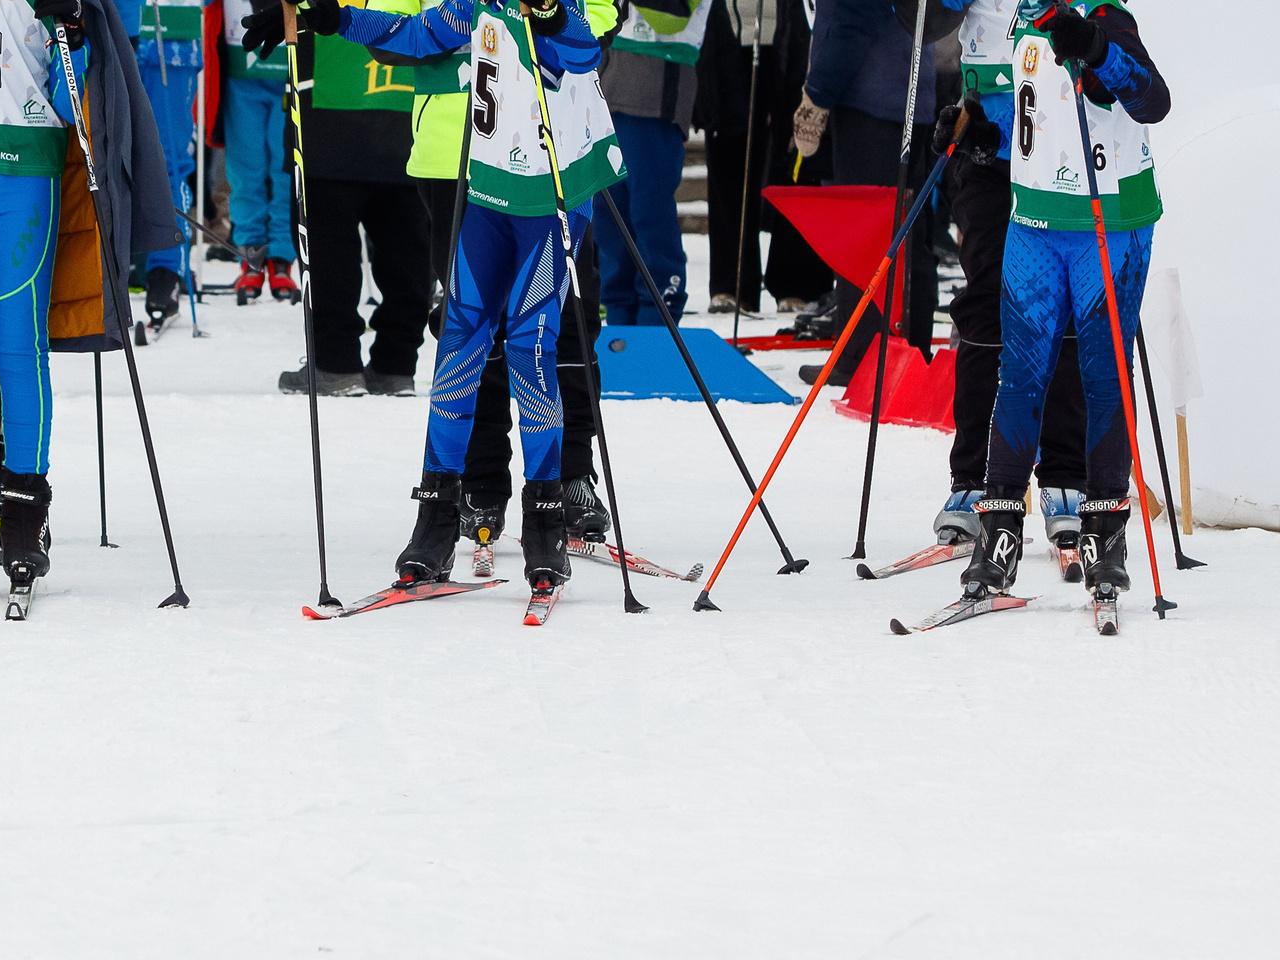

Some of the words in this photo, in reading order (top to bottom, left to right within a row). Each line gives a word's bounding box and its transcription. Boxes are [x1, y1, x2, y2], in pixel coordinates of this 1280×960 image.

[62, 46, 77, 91] NORDWAY
[471, 57, 500, 140] 5
[1016, 80, 1038, 161] 6
[1092, 143, 1107, 172] 6
[417, 491, 439, 499] TISA
